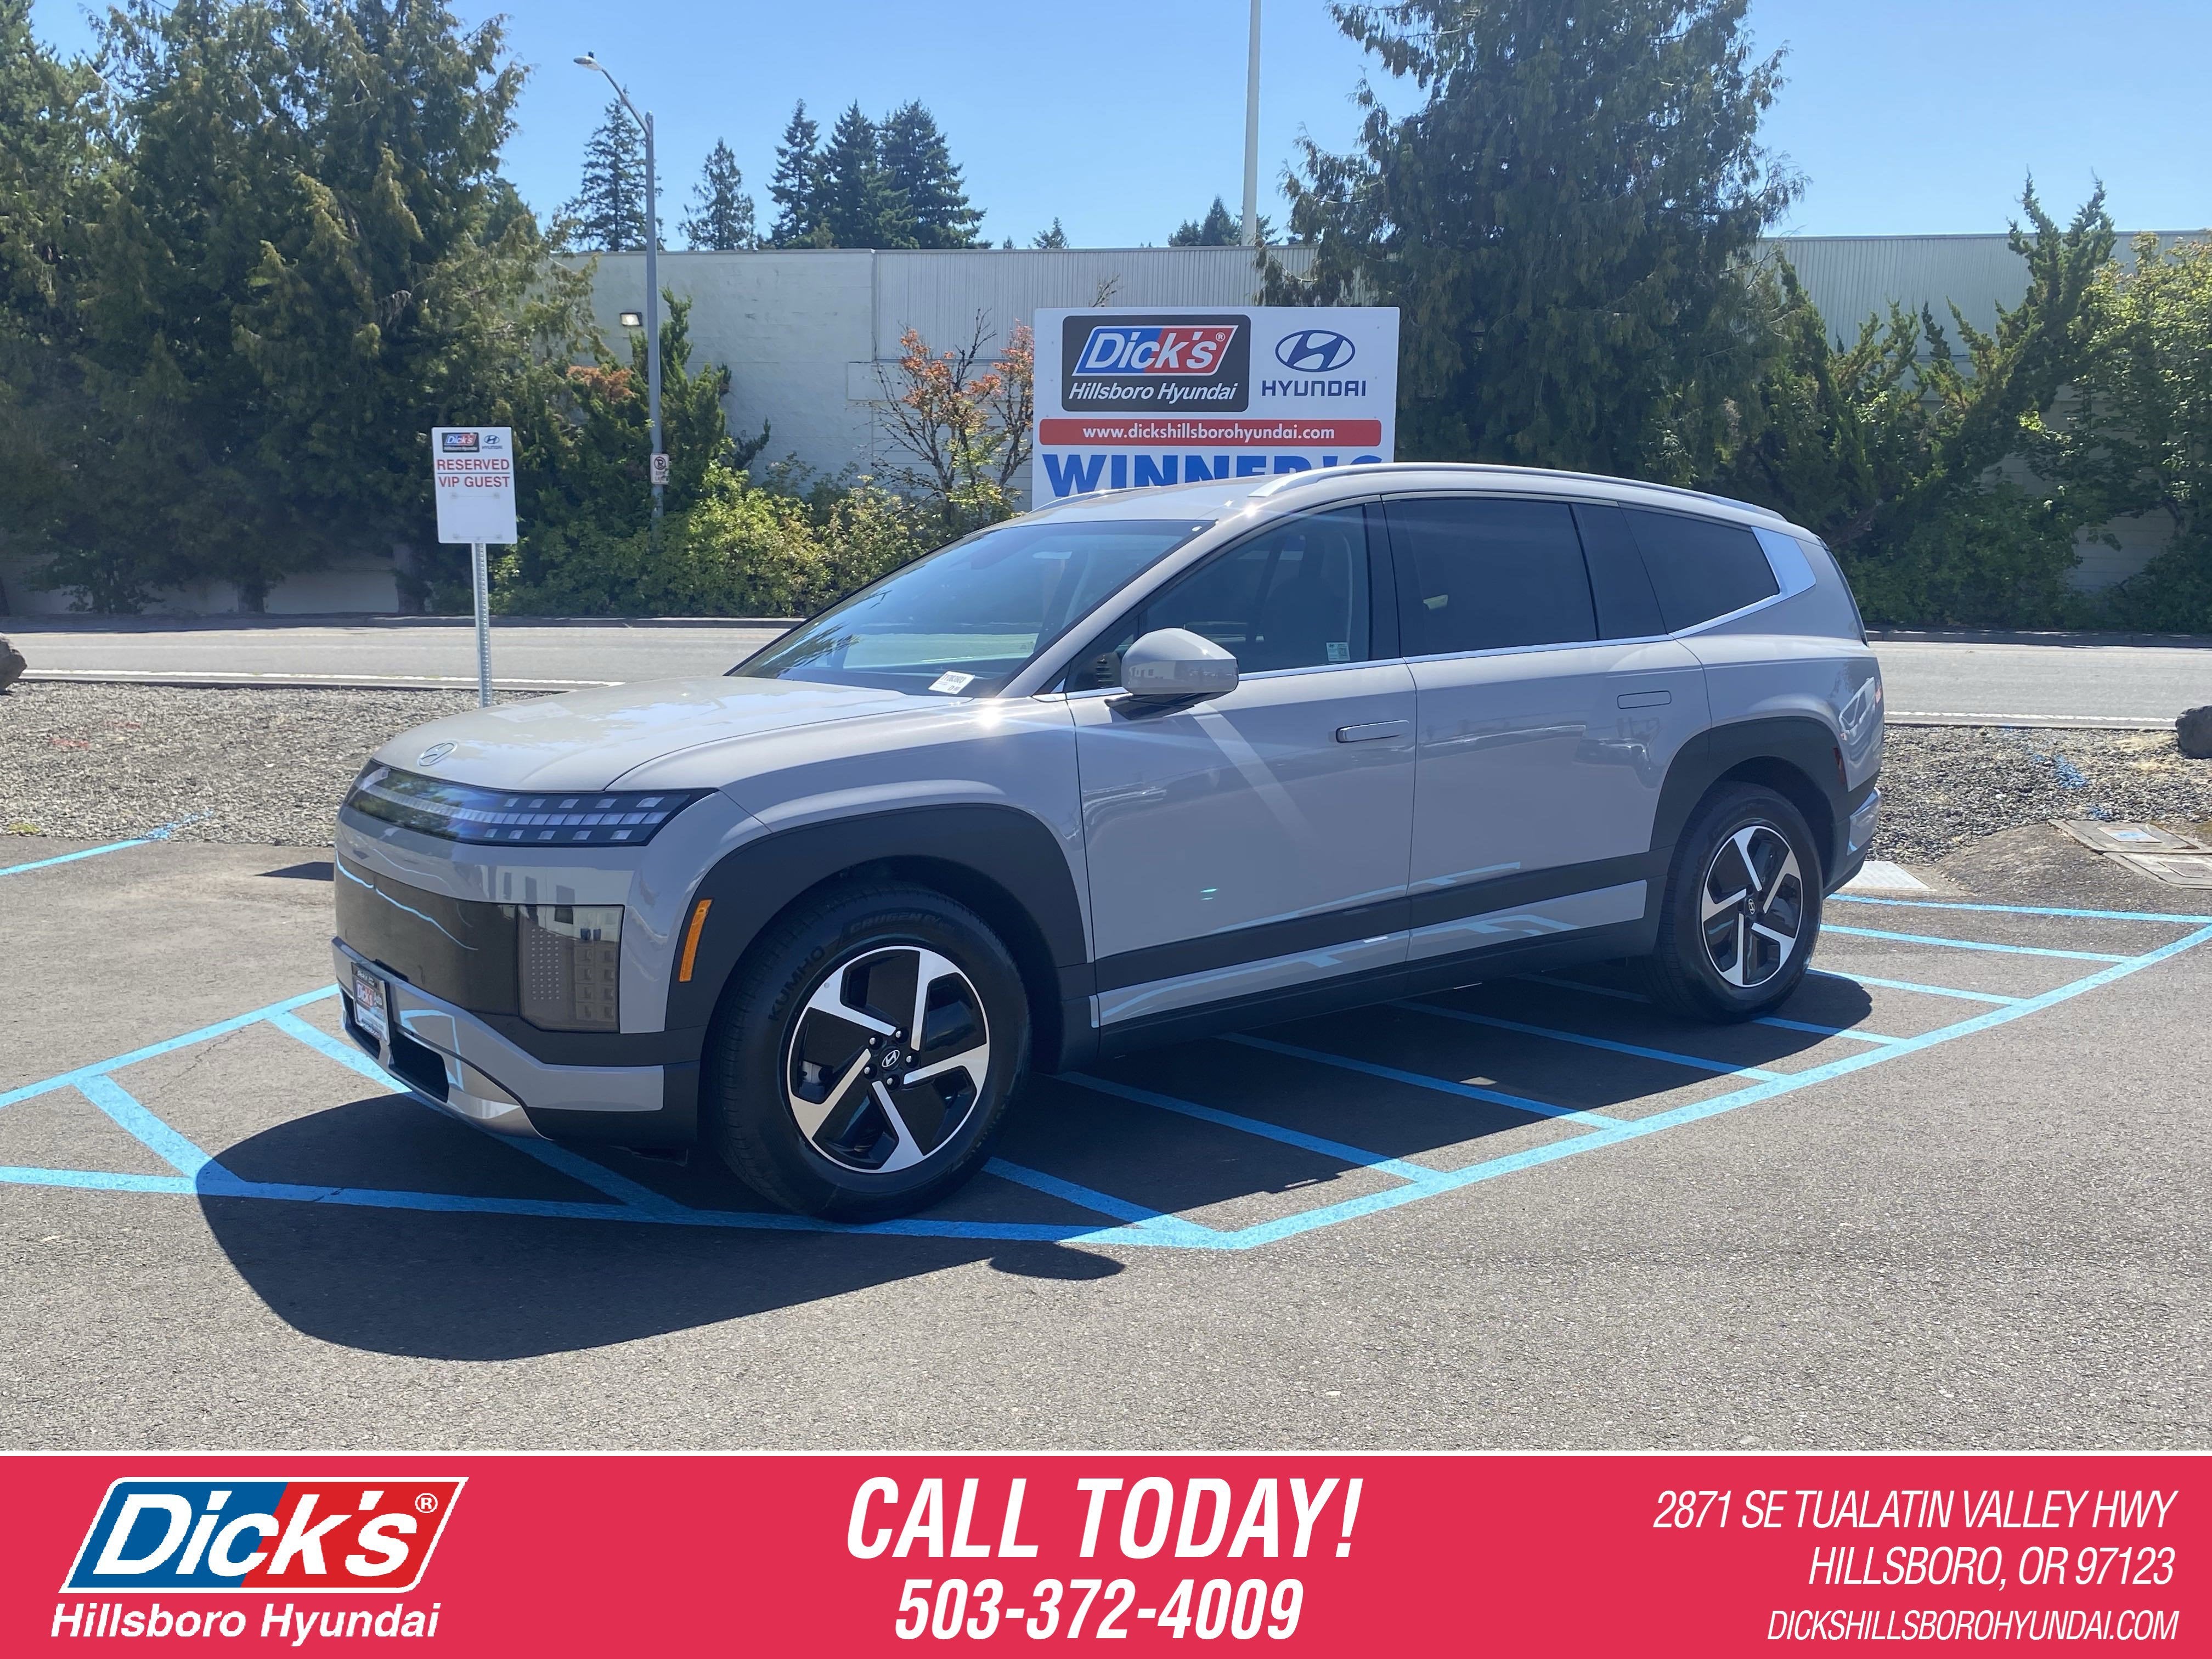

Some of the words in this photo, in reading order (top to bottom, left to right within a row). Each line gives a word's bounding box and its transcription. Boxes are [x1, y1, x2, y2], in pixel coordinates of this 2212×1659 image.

[1069, 382, 1154, 399] Hillsboro
[1156, 382, 1238, 404] Hyundai
[1261, 380, 1366, 396] HYUNDAI
[1082, 422, 1335, 443] www.dickshillsborohyundai.com
[437, 459, 510, 470] RESERVED
[439, 477, 459, 487] VIP
[464, 476, 510, 487] GUEST
[768, 945, 825, 1021] KUMHO
